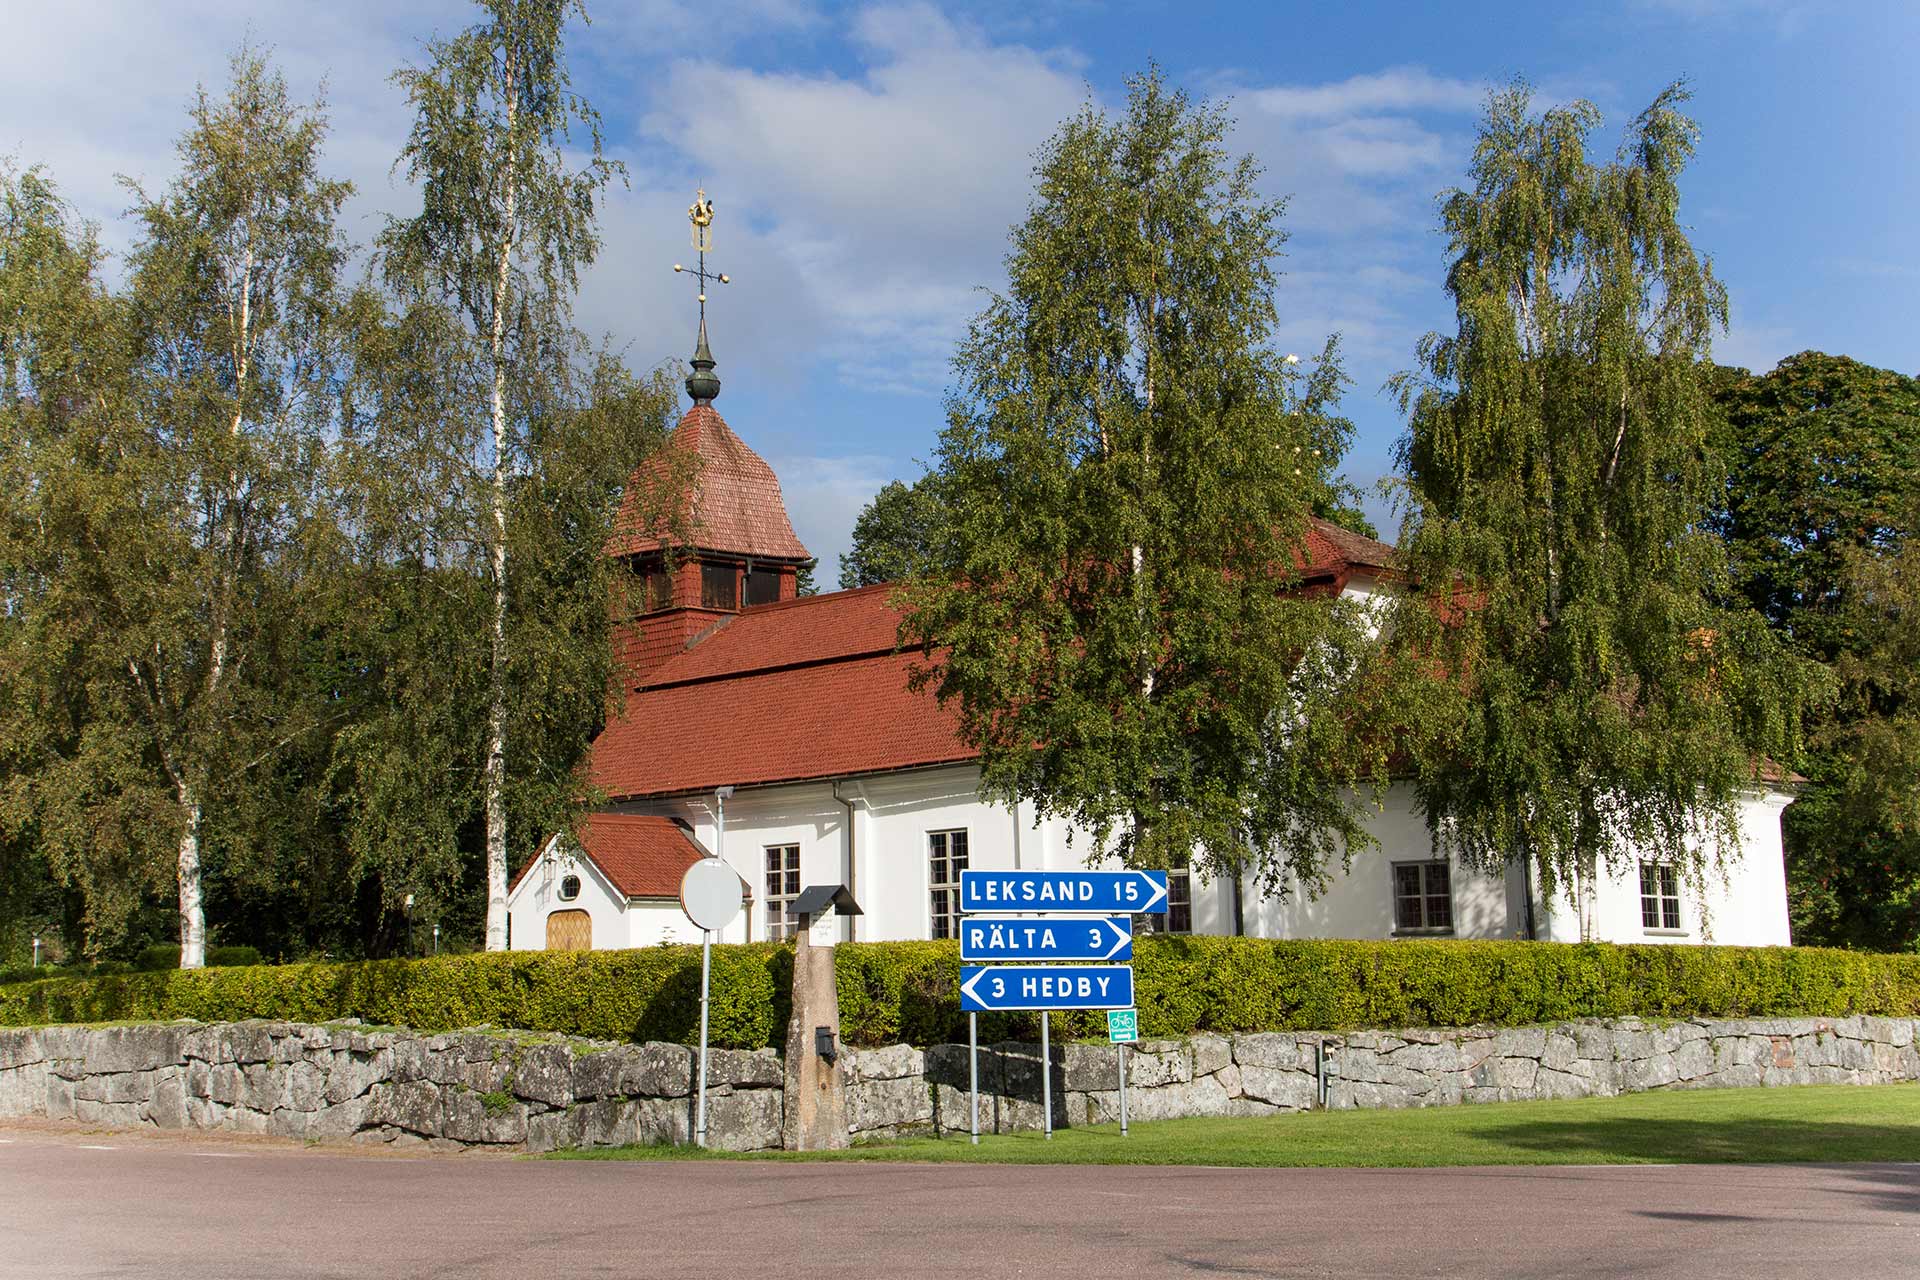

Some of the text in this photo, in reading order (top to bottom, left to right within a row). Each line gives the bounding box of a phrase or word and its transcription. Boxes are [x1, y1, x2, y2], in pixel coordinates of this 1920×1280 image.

[970, 880, 1138, 901] LEKSAND 15
[970, 924, 1102, 949] RÄLTA 3
[992, 976, 1111, 998] 3 HEDBY
